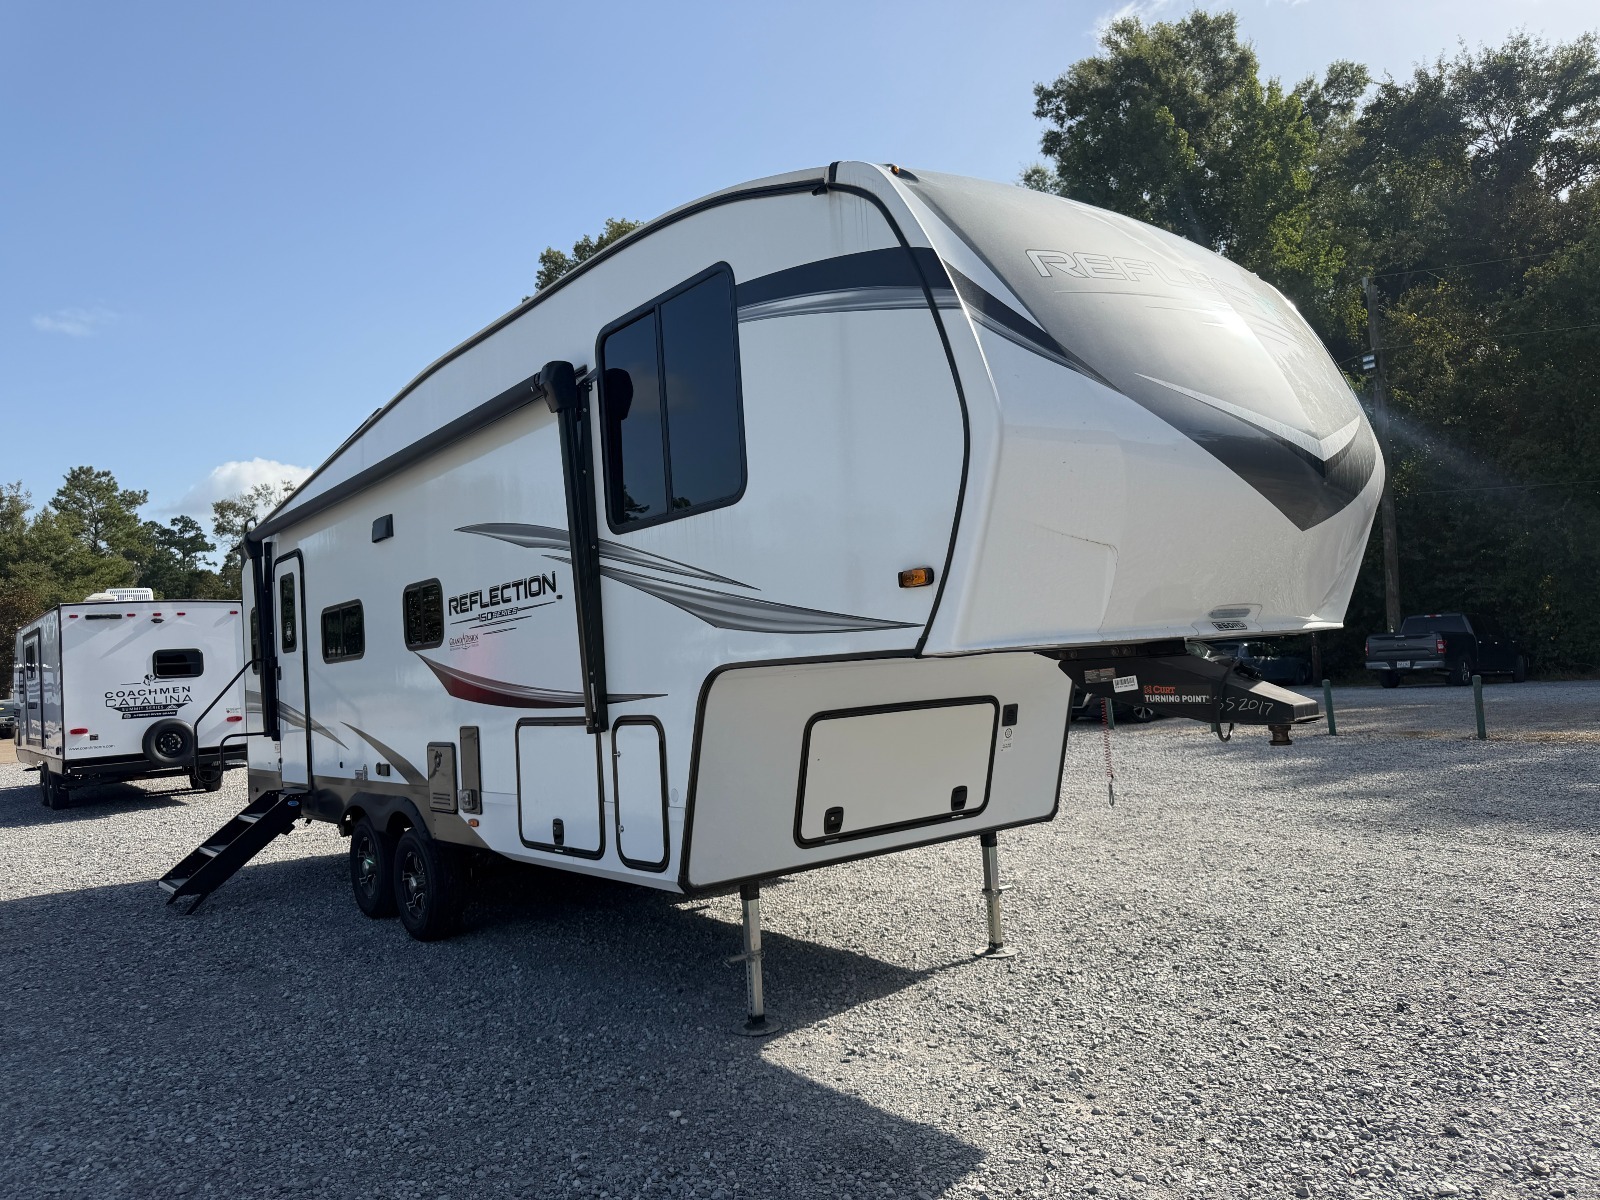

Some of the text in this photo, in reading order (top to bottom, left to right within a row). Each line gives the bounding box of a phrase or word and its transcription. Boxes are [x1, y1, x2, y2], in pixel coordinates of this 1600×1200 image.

[449, 571, 557, 616] REFLECTION
[104, 685, 191, 699] COACHMEN
[1153, 685, 1175, 693] CURT
[105, 694, 193, 708] CATALINA
[1144, 694, 1179, 703] TURNING
